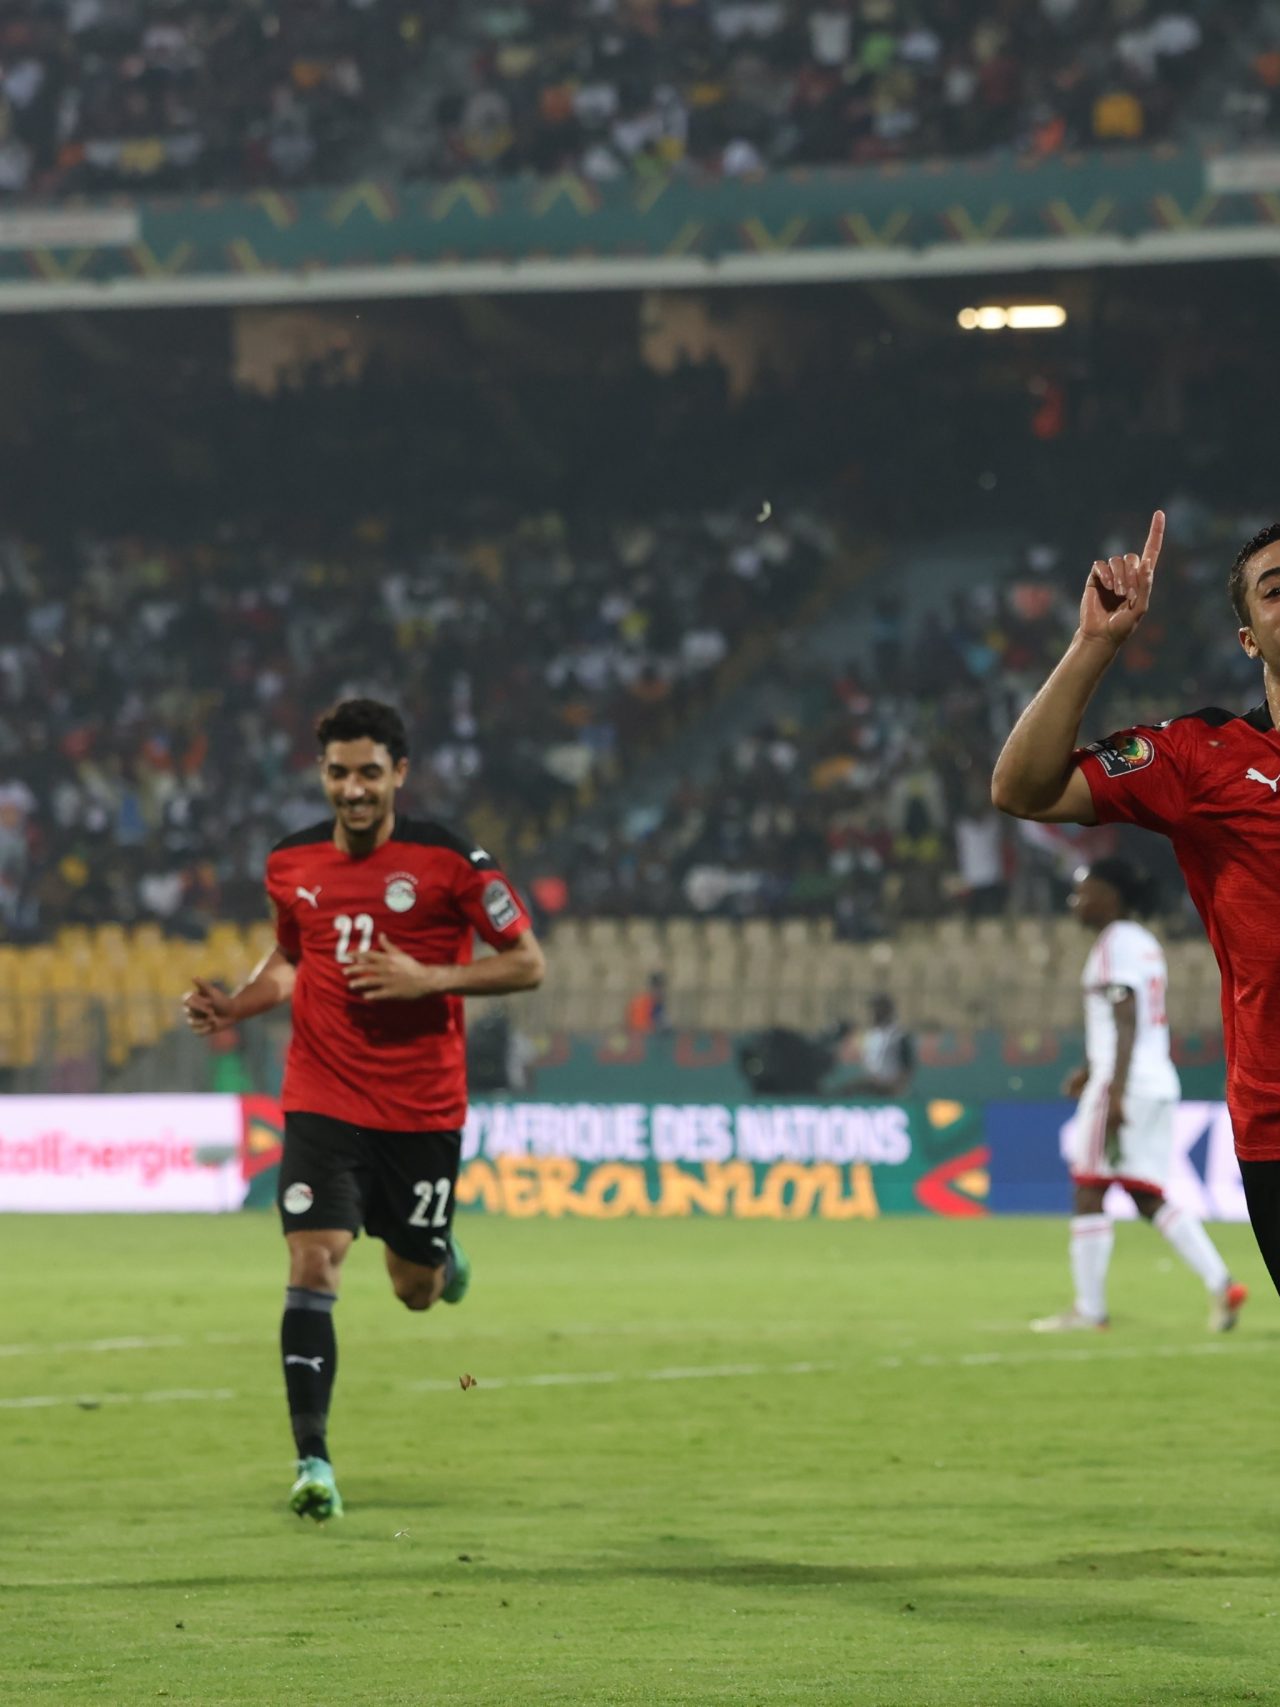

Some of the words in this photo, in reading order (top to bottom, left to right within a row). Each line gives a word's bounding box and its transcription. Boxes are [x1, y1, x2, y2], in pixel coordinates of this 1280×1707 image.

[333, 913, 374, 964] 22
[652, 1103, 734, 1163] DES
[737, 1104, 912, 1165] NATIONS
